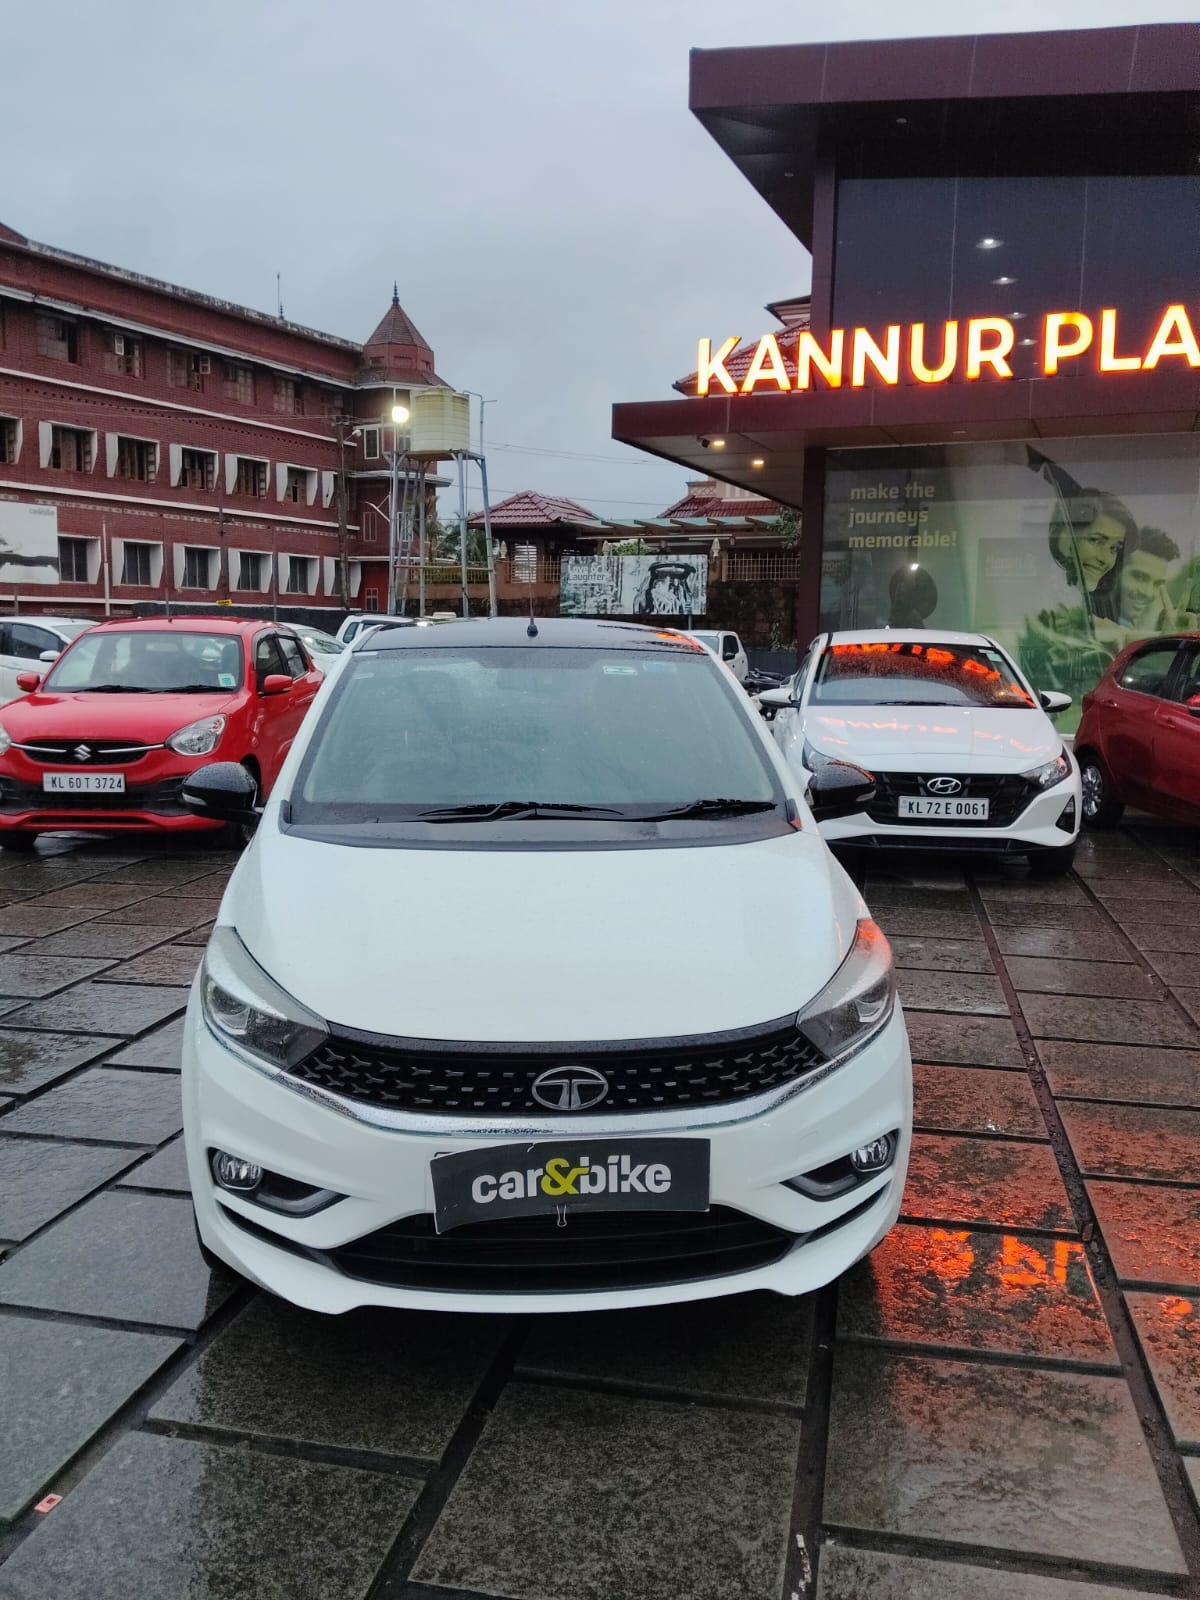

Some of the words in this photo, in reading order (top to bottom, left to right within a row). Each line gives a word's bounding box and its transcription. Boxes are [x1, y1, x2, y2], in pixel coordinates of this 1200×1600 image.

[697, 316, 1014, 396] KANNUR
[1043, 304, 1200, 375] PLA
[850, 483, 899, 500] make
[904, 481, 936, 498] the
[848, 508, 929, 527] journeys
[848, 530, 957, 549] memorable!
[51, 776, 64, 788] KL
[69, 777, 82, 788] 60
[84, 777, 91, 788] T
[95, 777, 122, 789] 3724
[908, 802, 923, 814] KL
[926, 802, 941, 814] 72
[945, 802, 952, 814] E
[956, 803, 986, 815] 0061
[471, 1155, 672, 1204] car&bike
